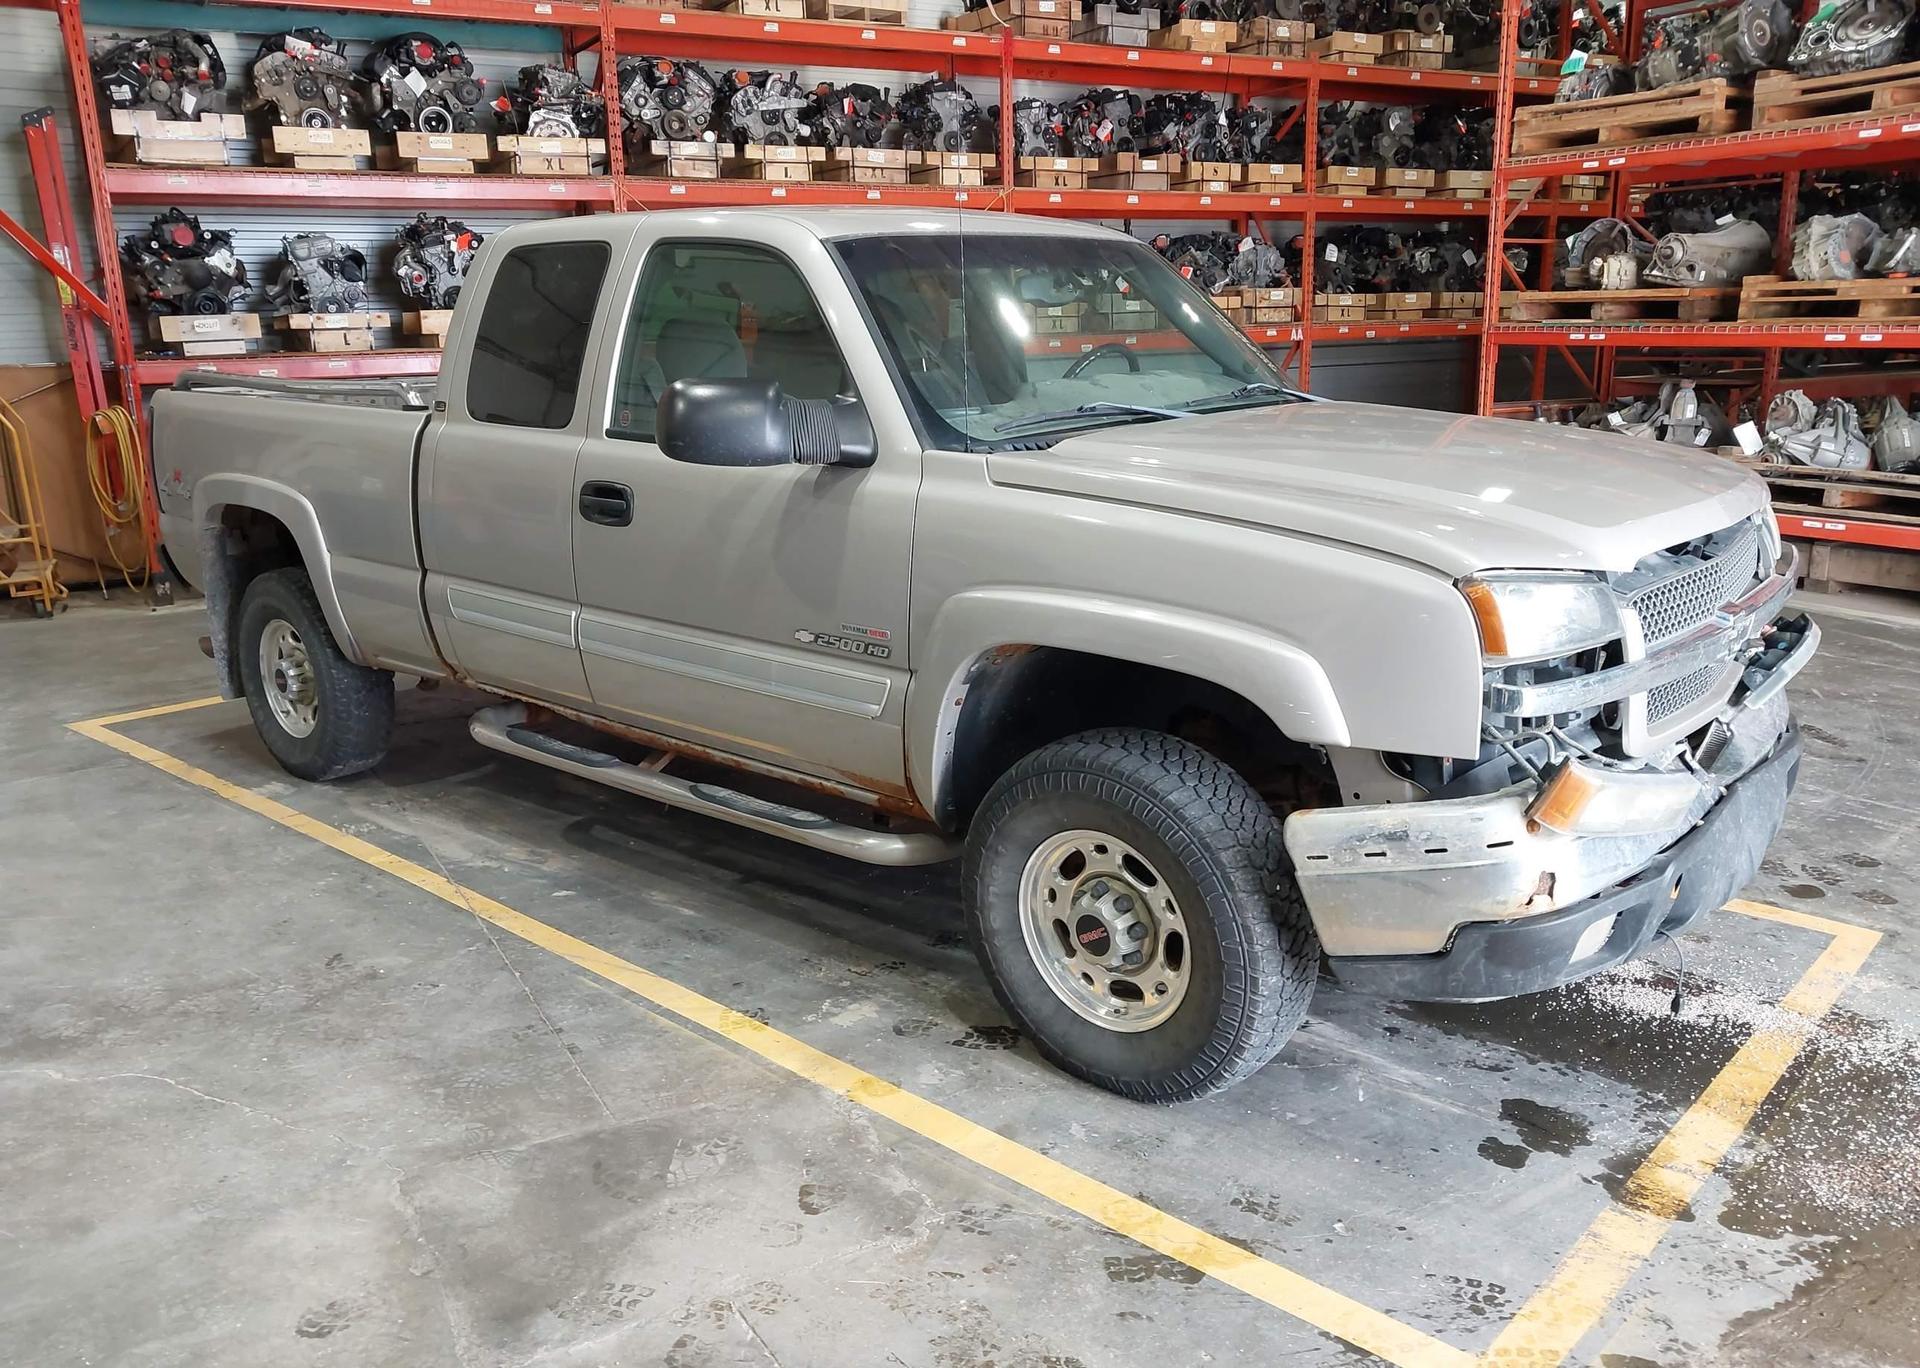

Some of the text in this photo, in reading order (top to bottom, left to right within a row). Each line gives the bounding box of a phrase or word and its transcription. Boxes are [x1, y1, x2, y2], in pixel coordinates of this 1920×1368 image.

[764, 0, 781, 12] XL
[545, 157, 566, 171] XL
[1053, 175, 1069, 187] XL
[1290, 327, 1304, 341] AA
[816, 633, 890, 658] 2500 HD
[1078, 927, 1108, 944] GMC
